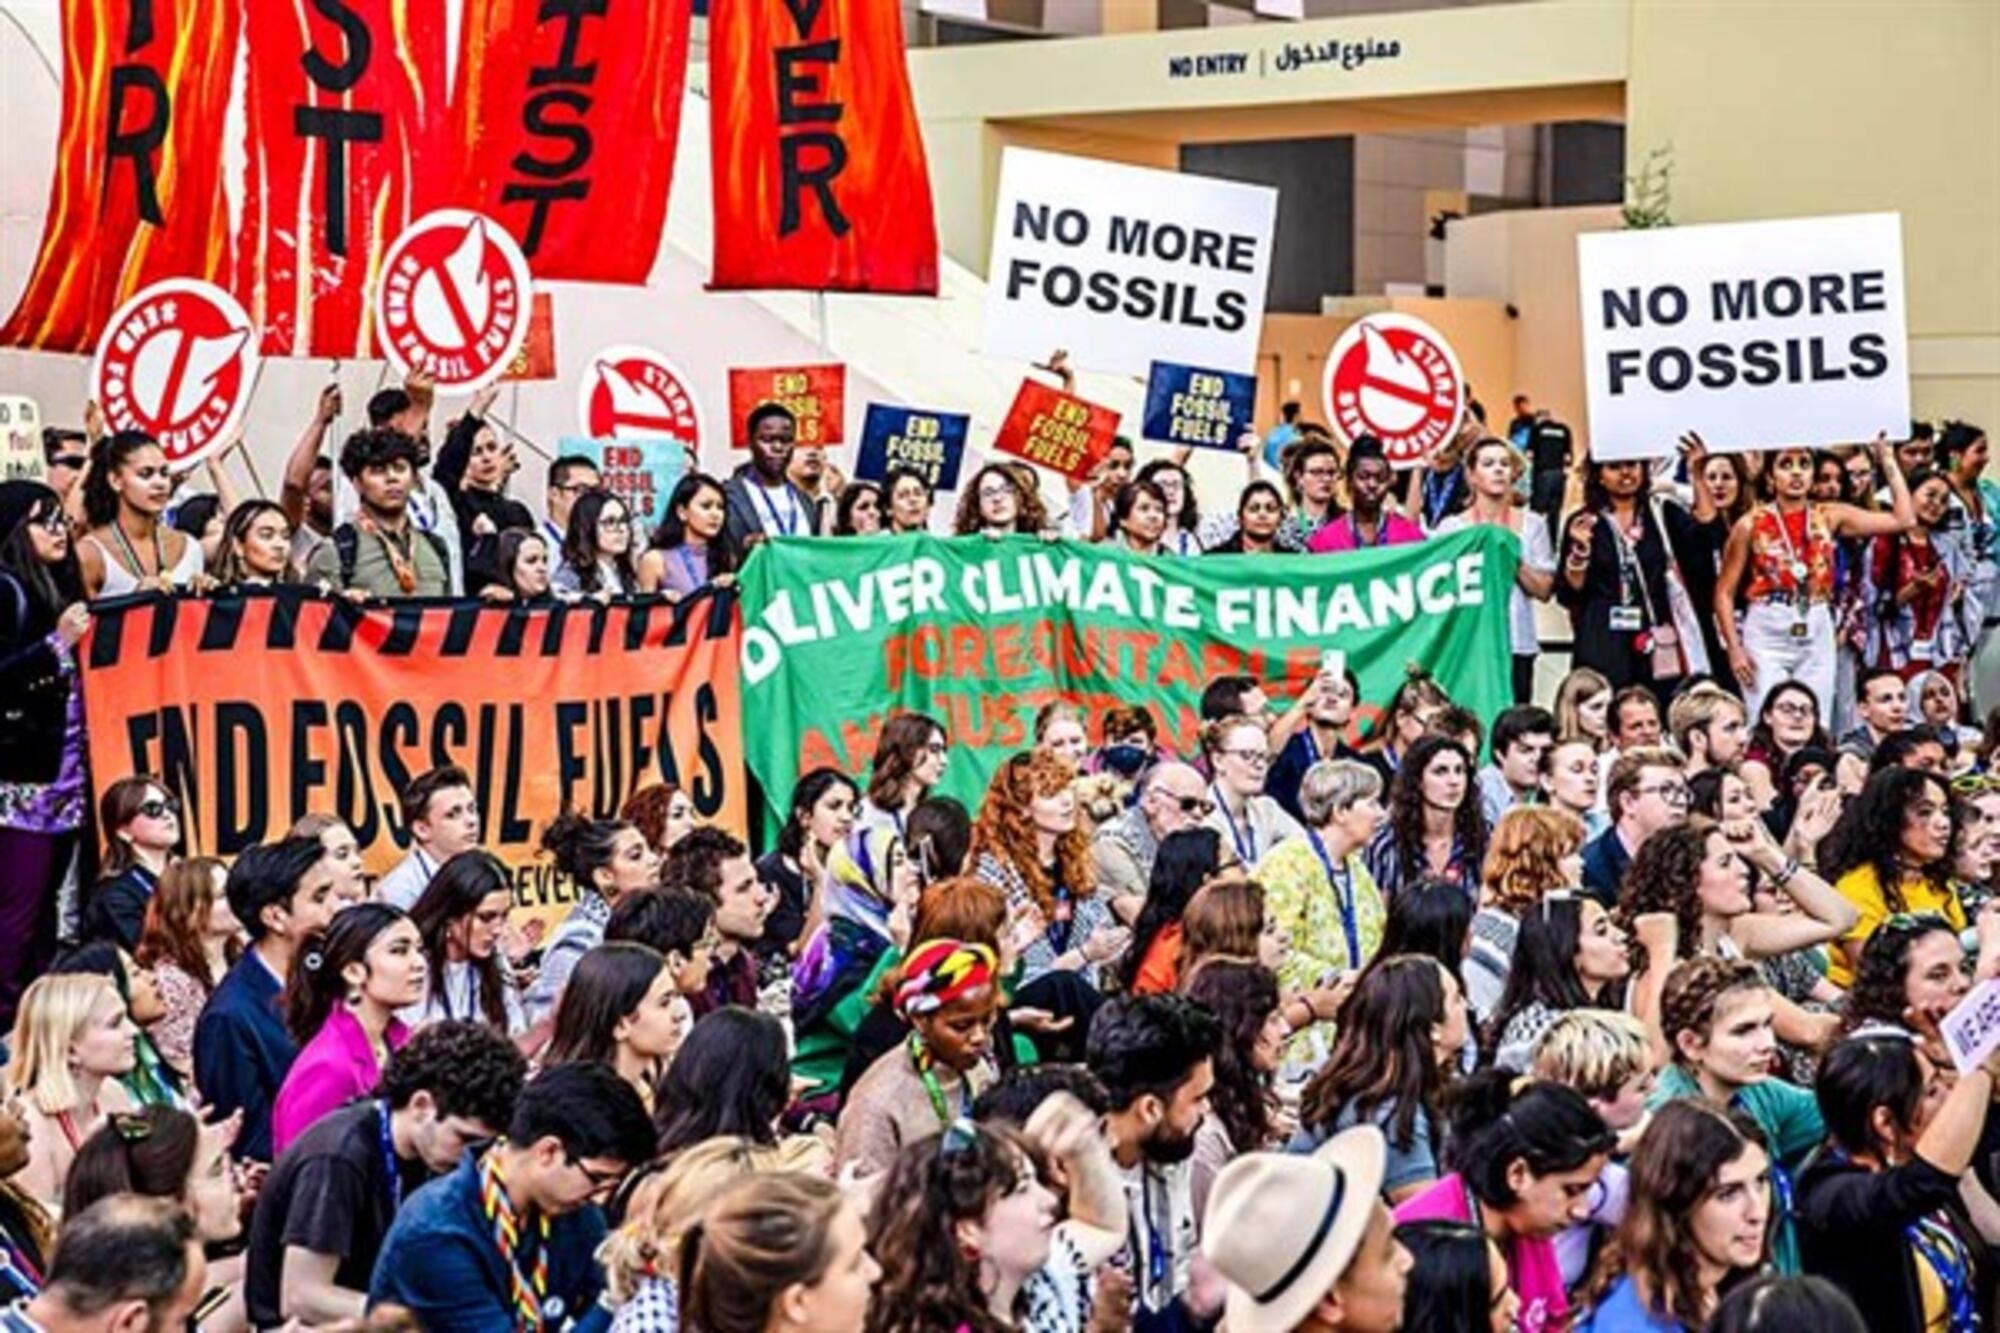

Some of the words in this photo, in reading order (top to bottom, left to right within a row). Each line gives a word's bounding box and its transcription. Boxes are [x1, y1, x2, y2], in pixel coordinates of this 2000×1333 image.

[1169, 57, 1192, 78] NO
[1196, 54, 1248, 77] ENTRY
[1276, 39, 1340, 72] الدخول
[1342, 37, 1401, 71] ممنوع
[1012, 201, 1090, 247] NO
[1107, 215, 1258, 274] MORE
[1006, 259, 1248, 333] FOSSILS
[1601, 283, 1689, 330] NO
[1710, 270, 1887, 322] MORE
[475, 276, 515, 365] FUELS
[1606, 332, 1889, 396] FOSSILS
[773, 372, 808, 397] END
[1189, 372, 1225, 399] END
[1053, 398, 1089, 428] END
[1169, 391, 1234, 425] FOSSIL
[906, 414, 940, 440] END
[1028, 412, 1091, 455] FOSSIL
[1168, 416, 1228, 445] FUELS
[603, 445, 644, 469] END
[885, 433, 946, 464] FOSSIL
[1022, 435, 1081, 472] FUELS
[1216, 552, 1485, 639] FINANCE
